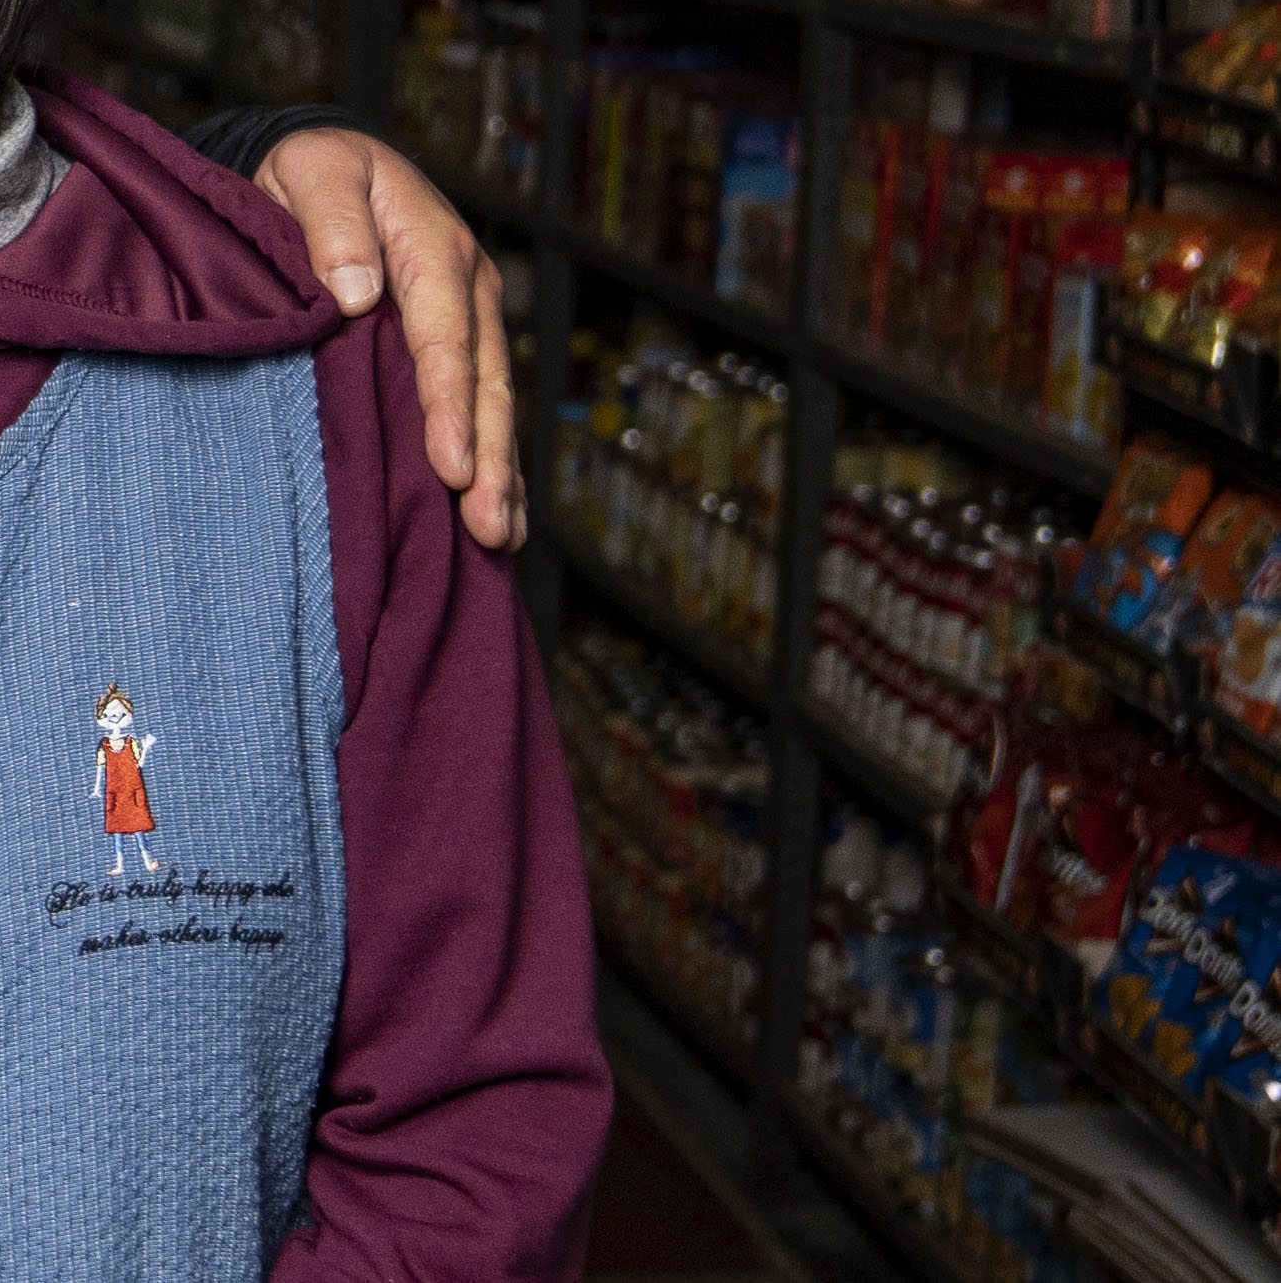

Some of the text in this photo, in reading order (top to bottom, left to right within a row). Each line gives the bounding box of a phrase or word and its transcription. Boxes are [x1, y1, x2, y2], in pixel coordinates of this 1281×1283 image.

[100, 883, 119, 902] is
[127, 869, 184, 907] truly
[193, 870, 255, 907] happy
[263, 872, 294, 897] who
[78, 916, 284, 956] makes others happy
